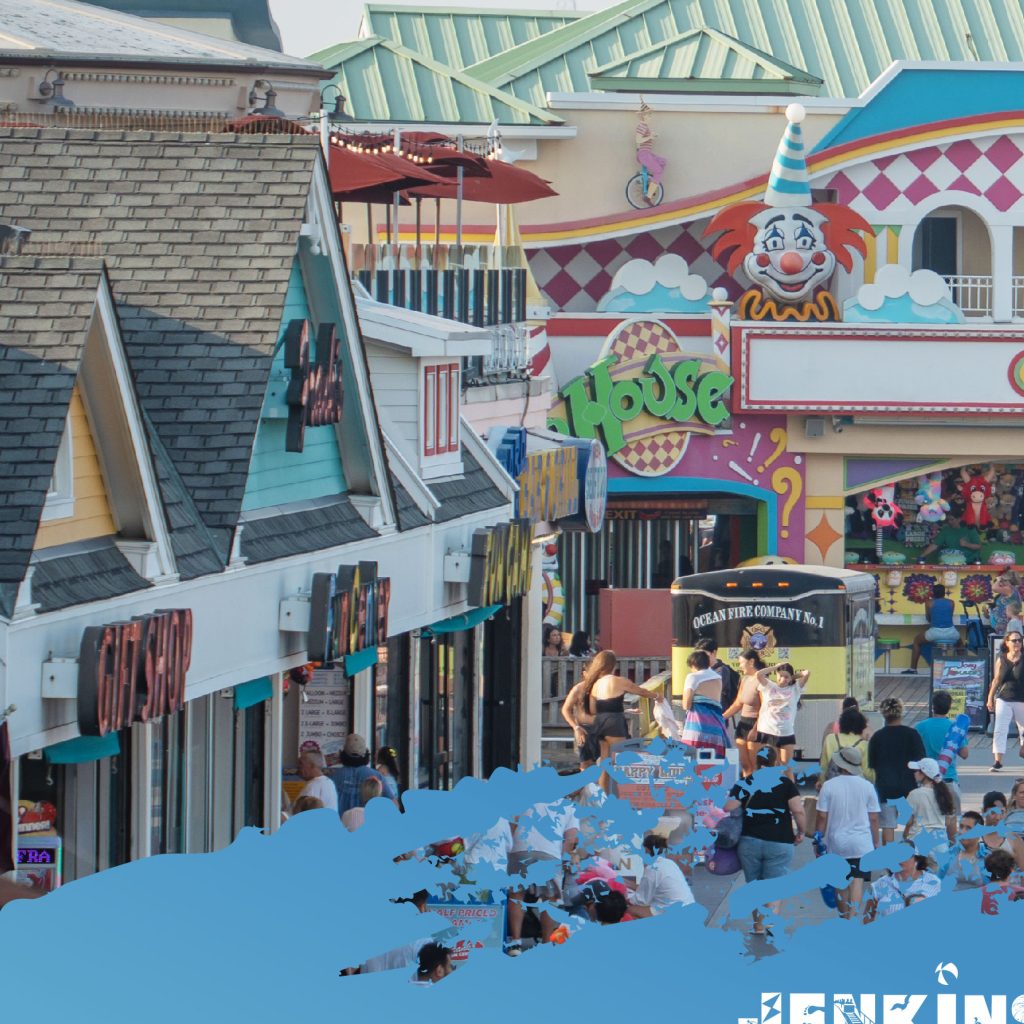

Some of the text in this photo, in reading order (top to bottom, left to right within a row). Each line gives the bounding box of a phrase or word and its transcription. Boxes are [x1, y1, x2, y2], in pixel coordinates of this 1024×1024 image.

[606, 510, 637, 520] EXIT
[693, 608, 727, 629] OCEAN
[728, 605, 754, 619] FIRE
[754, 604, 802, 622] COMPANY
